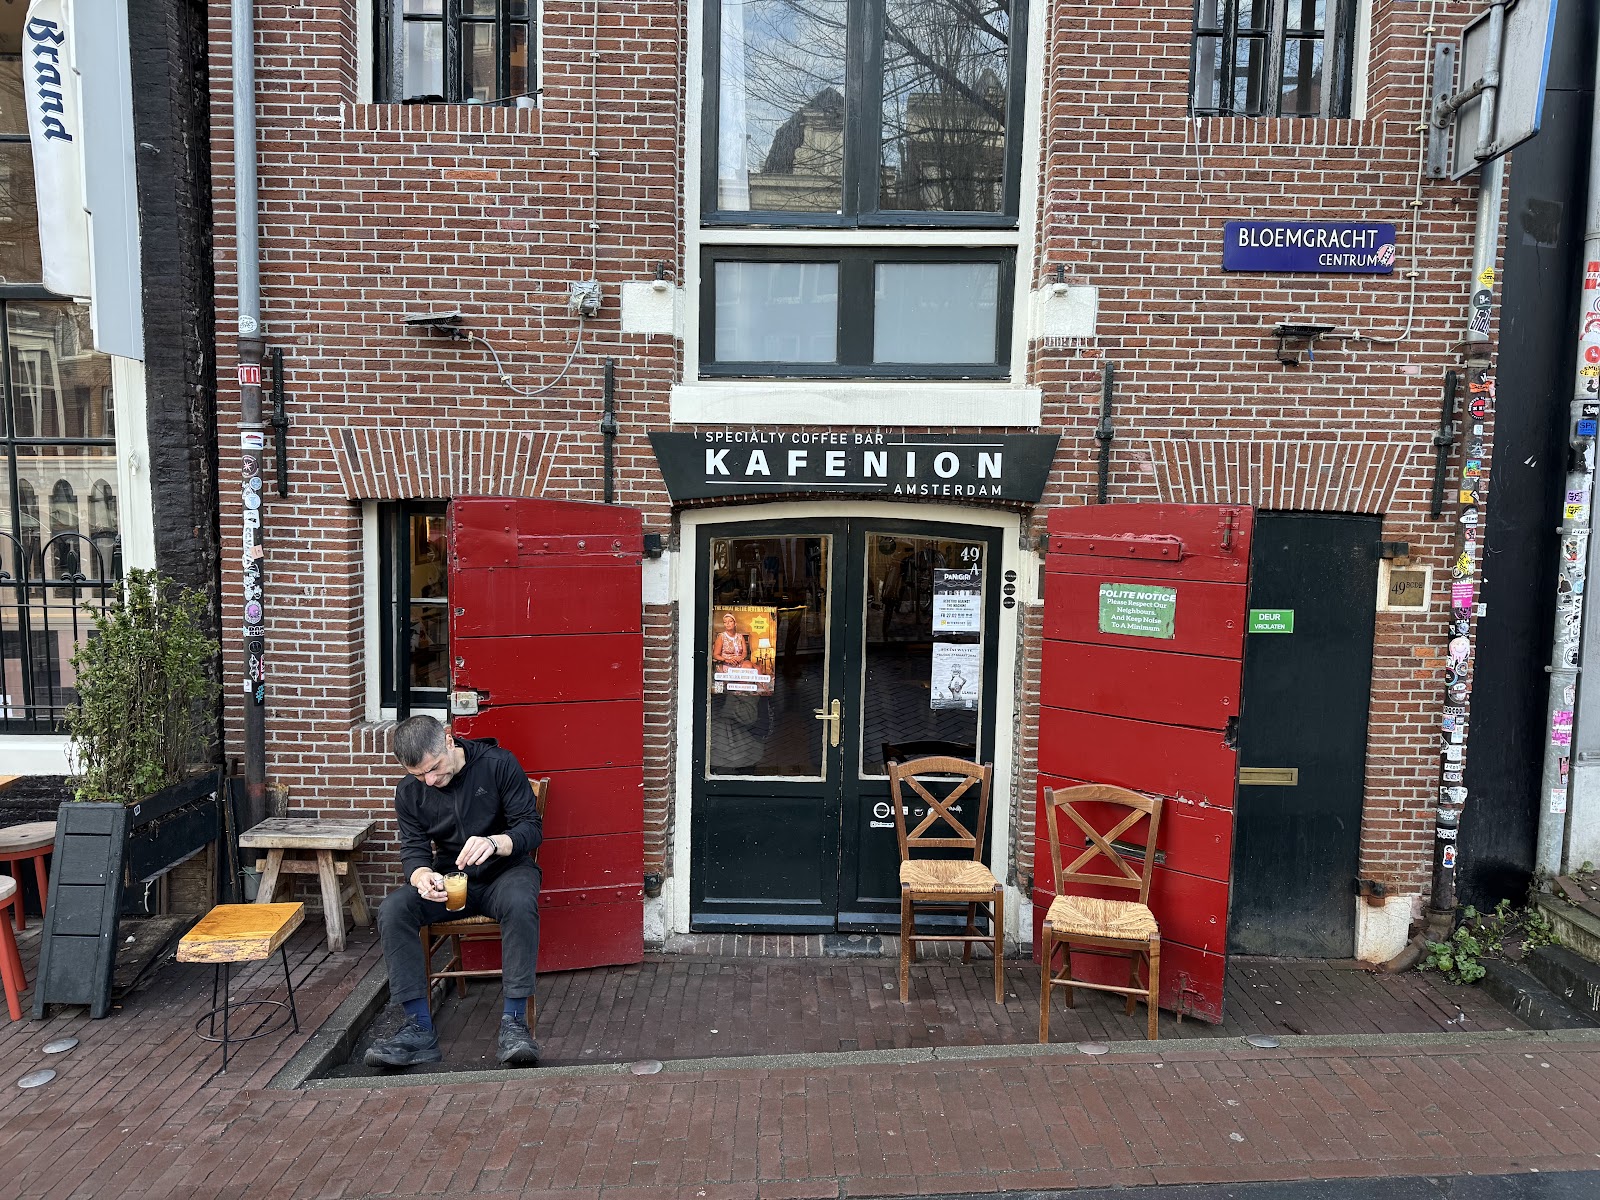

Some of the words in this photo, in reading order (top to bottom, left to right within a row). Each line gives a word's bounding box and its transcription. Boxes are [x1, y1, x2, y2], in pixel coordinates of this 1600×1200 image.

[26, 16, 73, 143] Brand
[1238, 228, 1378, 249] BLOEMGRACHT
[1318, 253, 1377, 266] CENTRUM
[705, 431, 785, 443] SPECIALTY
[791, 433, 848, 444] COFFEE
[854, 433, 884, 445] BAR
[705, 449, 1003, 479] KAFENION
[893, 484, 1002, 496] AMSTERDAM
[960, 546, 980, 562] 49
[970, 562, 980, 576] A
[1099, 590, 1135, 600] POLITE
[1136, 592, 1176, 602] NOTICE
[1107, 598, 1128, 606] Please
[1127, 600, 1153, 608] Respect
[1125, 615, 1143, 623] Keep
[1142, 616, 1162, 625] Noise
[1258, 613, 1281, 621] DEUR
[1126, 623, 1161, 632] Minimum
